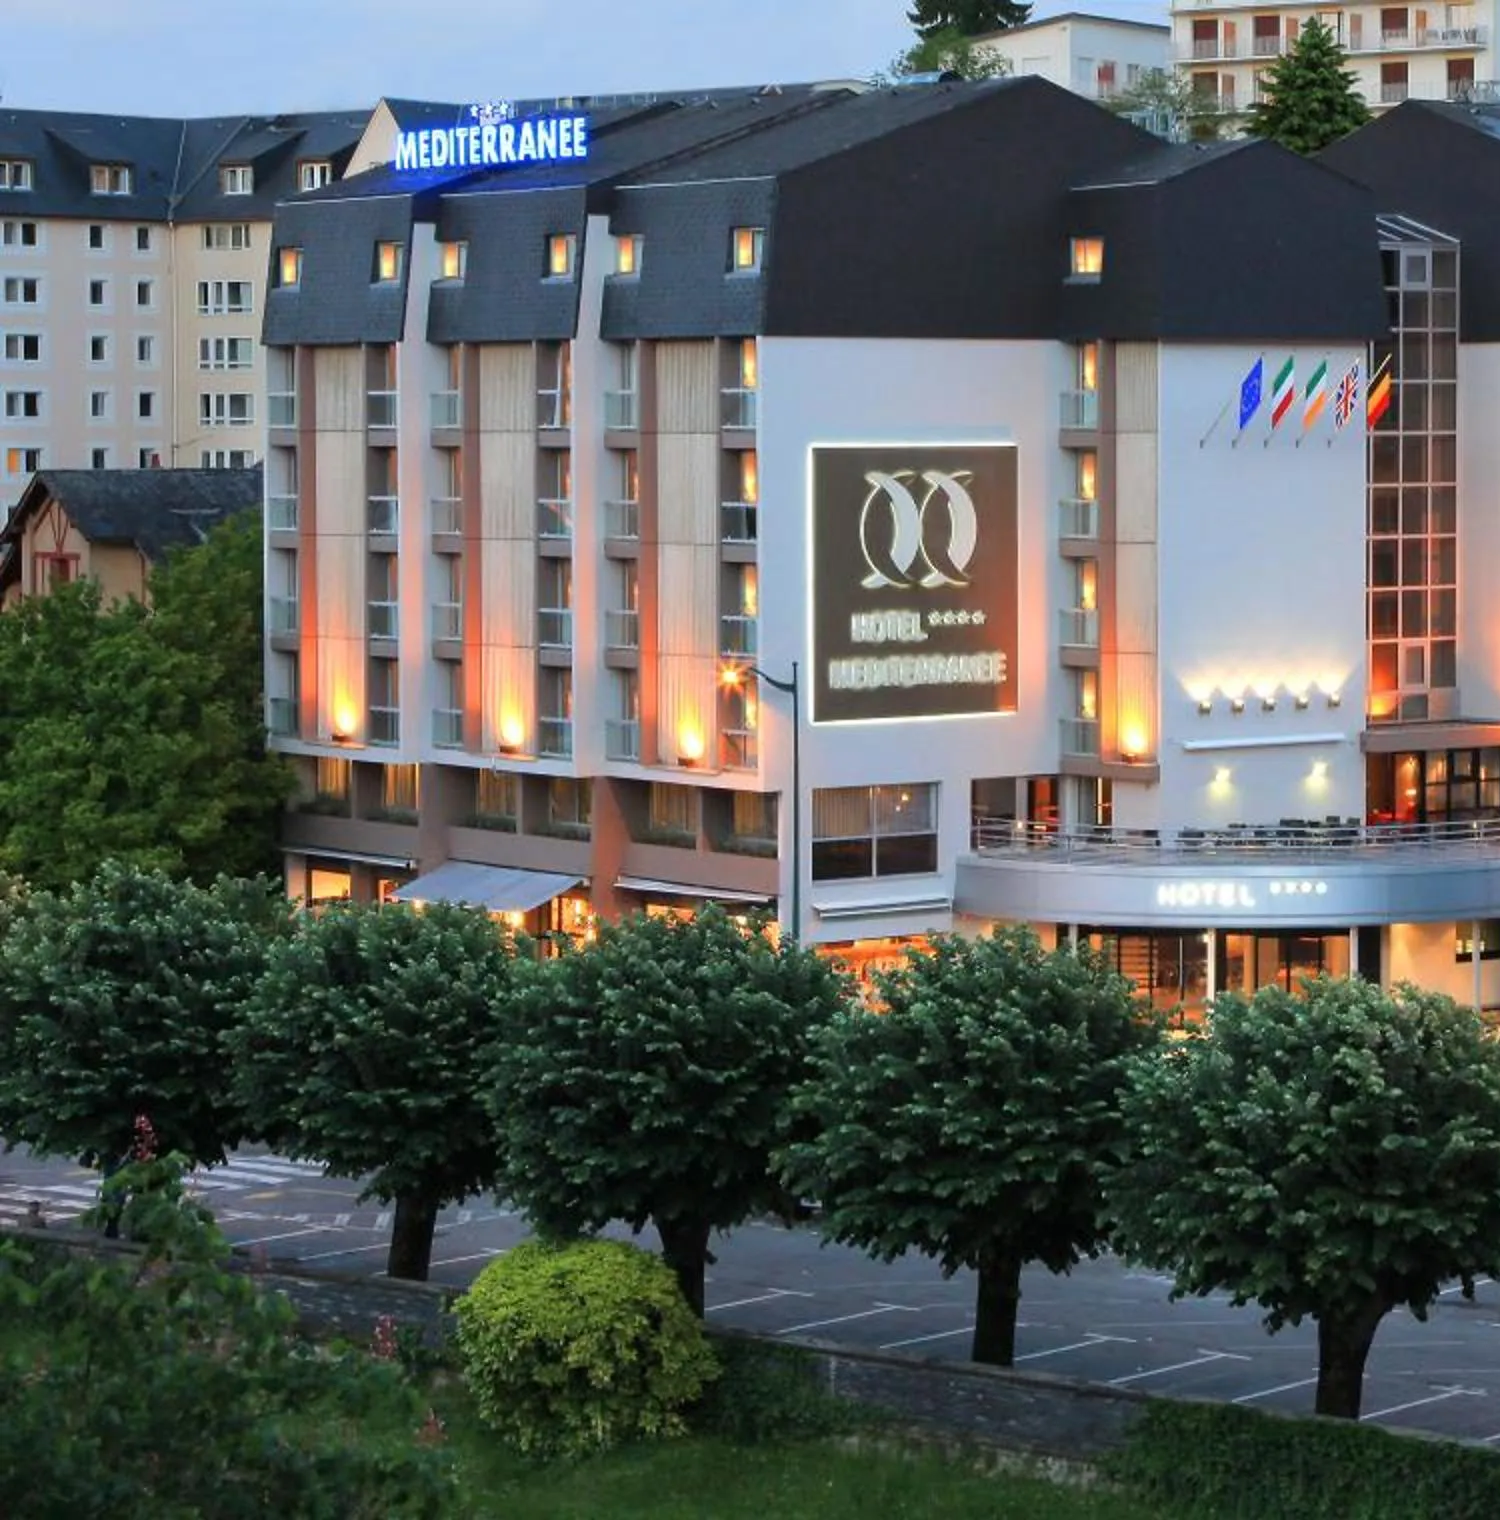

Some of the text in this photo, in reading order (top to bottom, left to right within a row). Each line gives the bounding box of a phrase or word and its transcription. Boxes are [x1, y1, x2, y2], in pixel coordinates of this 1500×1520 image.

[395, 117, 588, 170] MEDITERRANEE
[851, 610, 929, 643] HOTEL
[828, 652, 1008, 689] MEDITERRANEE
[1157, 882, 1256, 907] HOTEL
